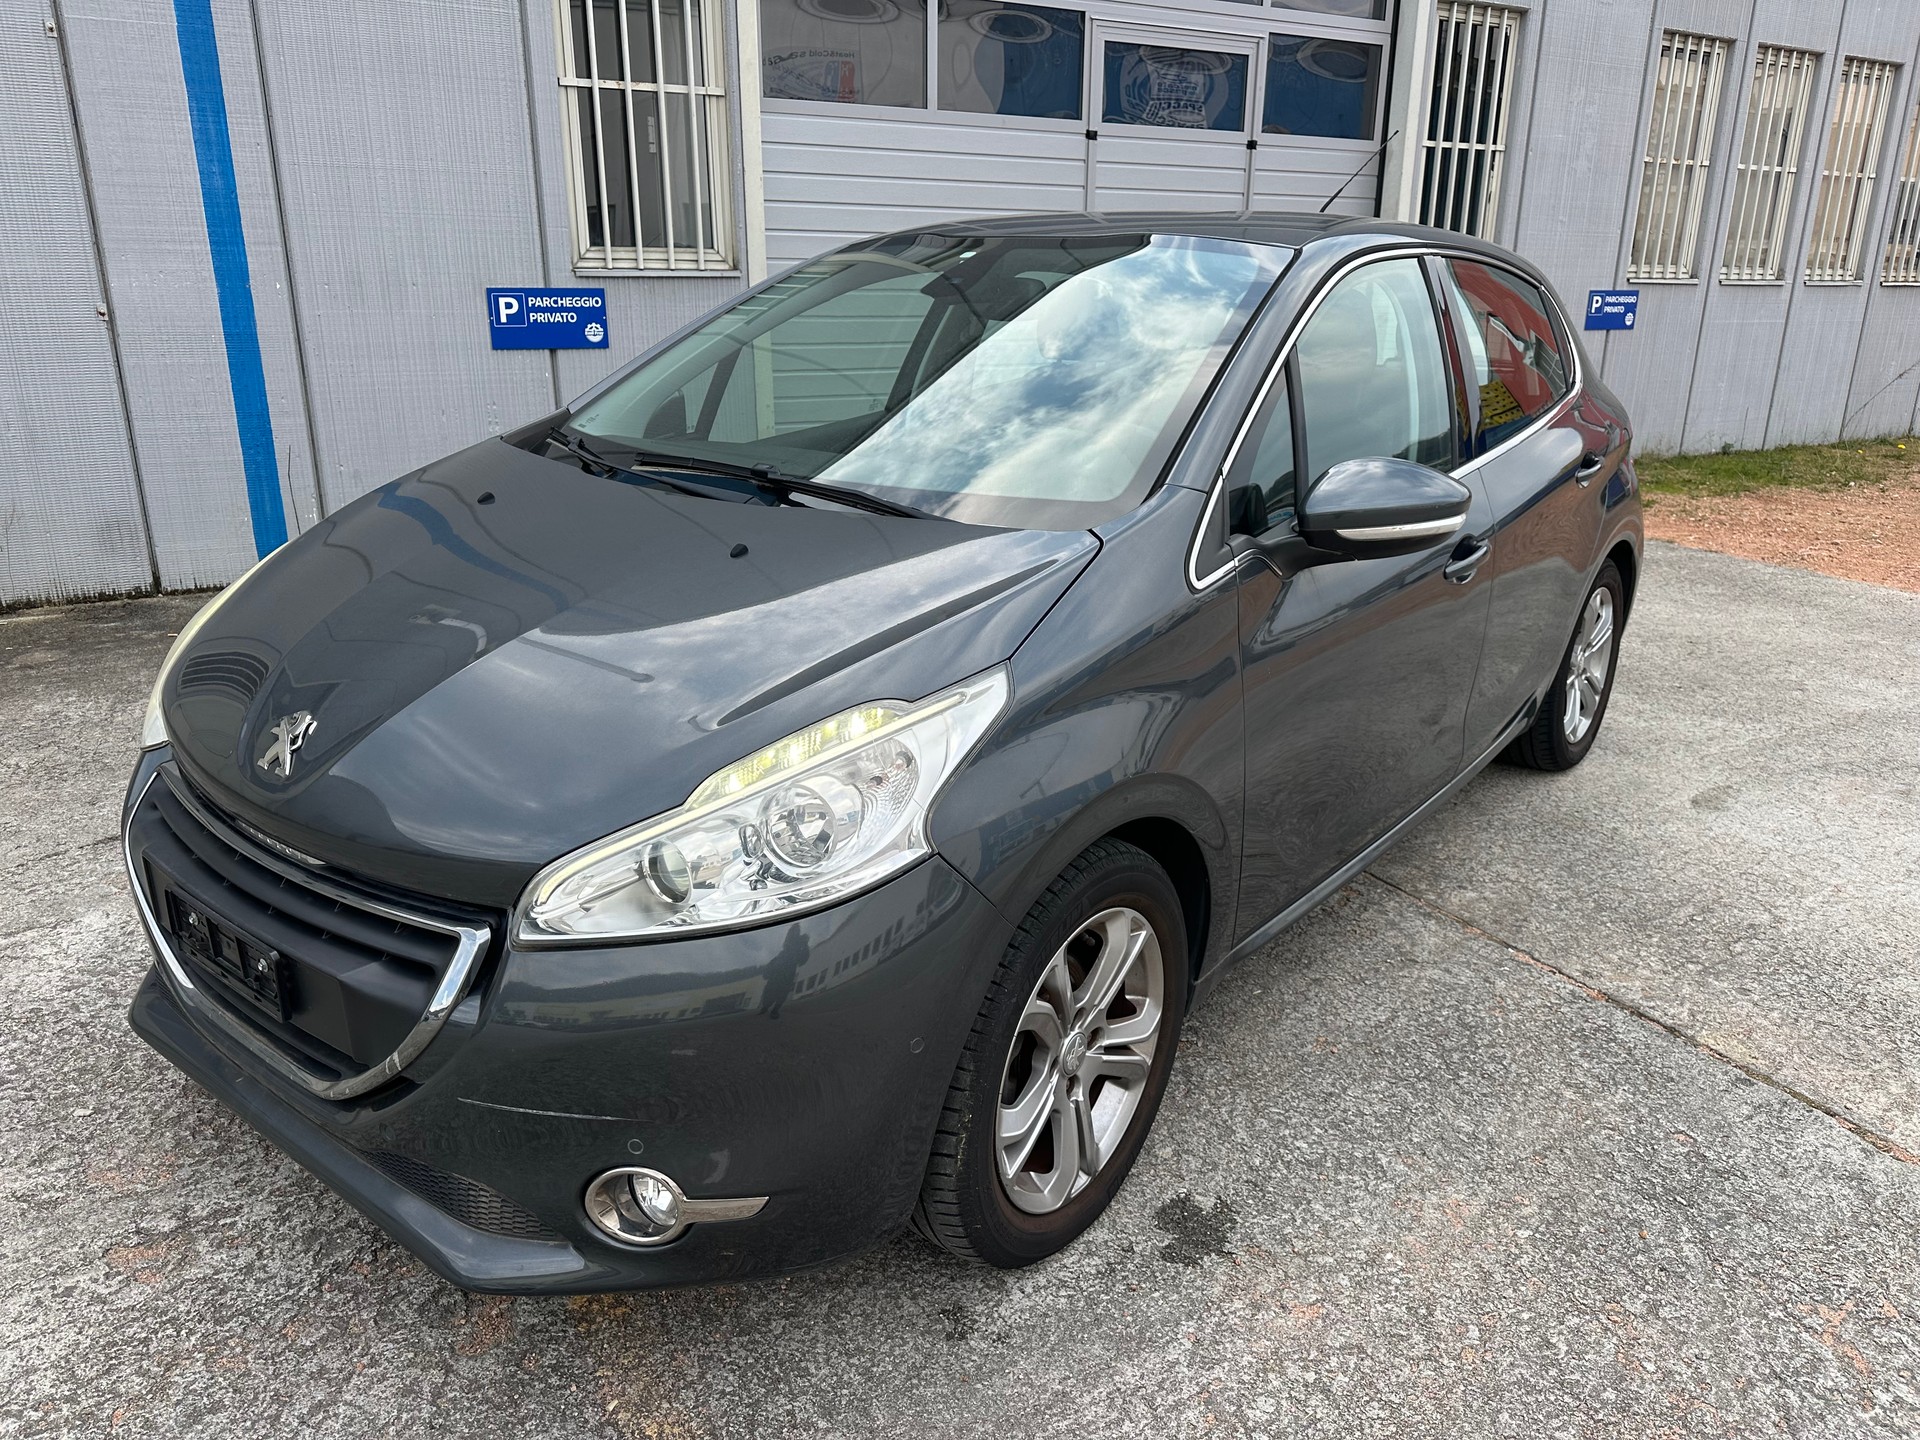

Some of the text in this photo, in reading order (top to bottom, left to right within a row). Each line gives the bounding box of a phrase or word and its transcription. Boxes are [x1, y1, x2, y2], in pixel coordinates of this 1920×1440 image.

[528, 297, 602, 307] PARCHEGGIO
[1591, 296, 1602, 313] P
[499, 297, 519, 323] P
[529, 313, 577, 323] PRIVATO
